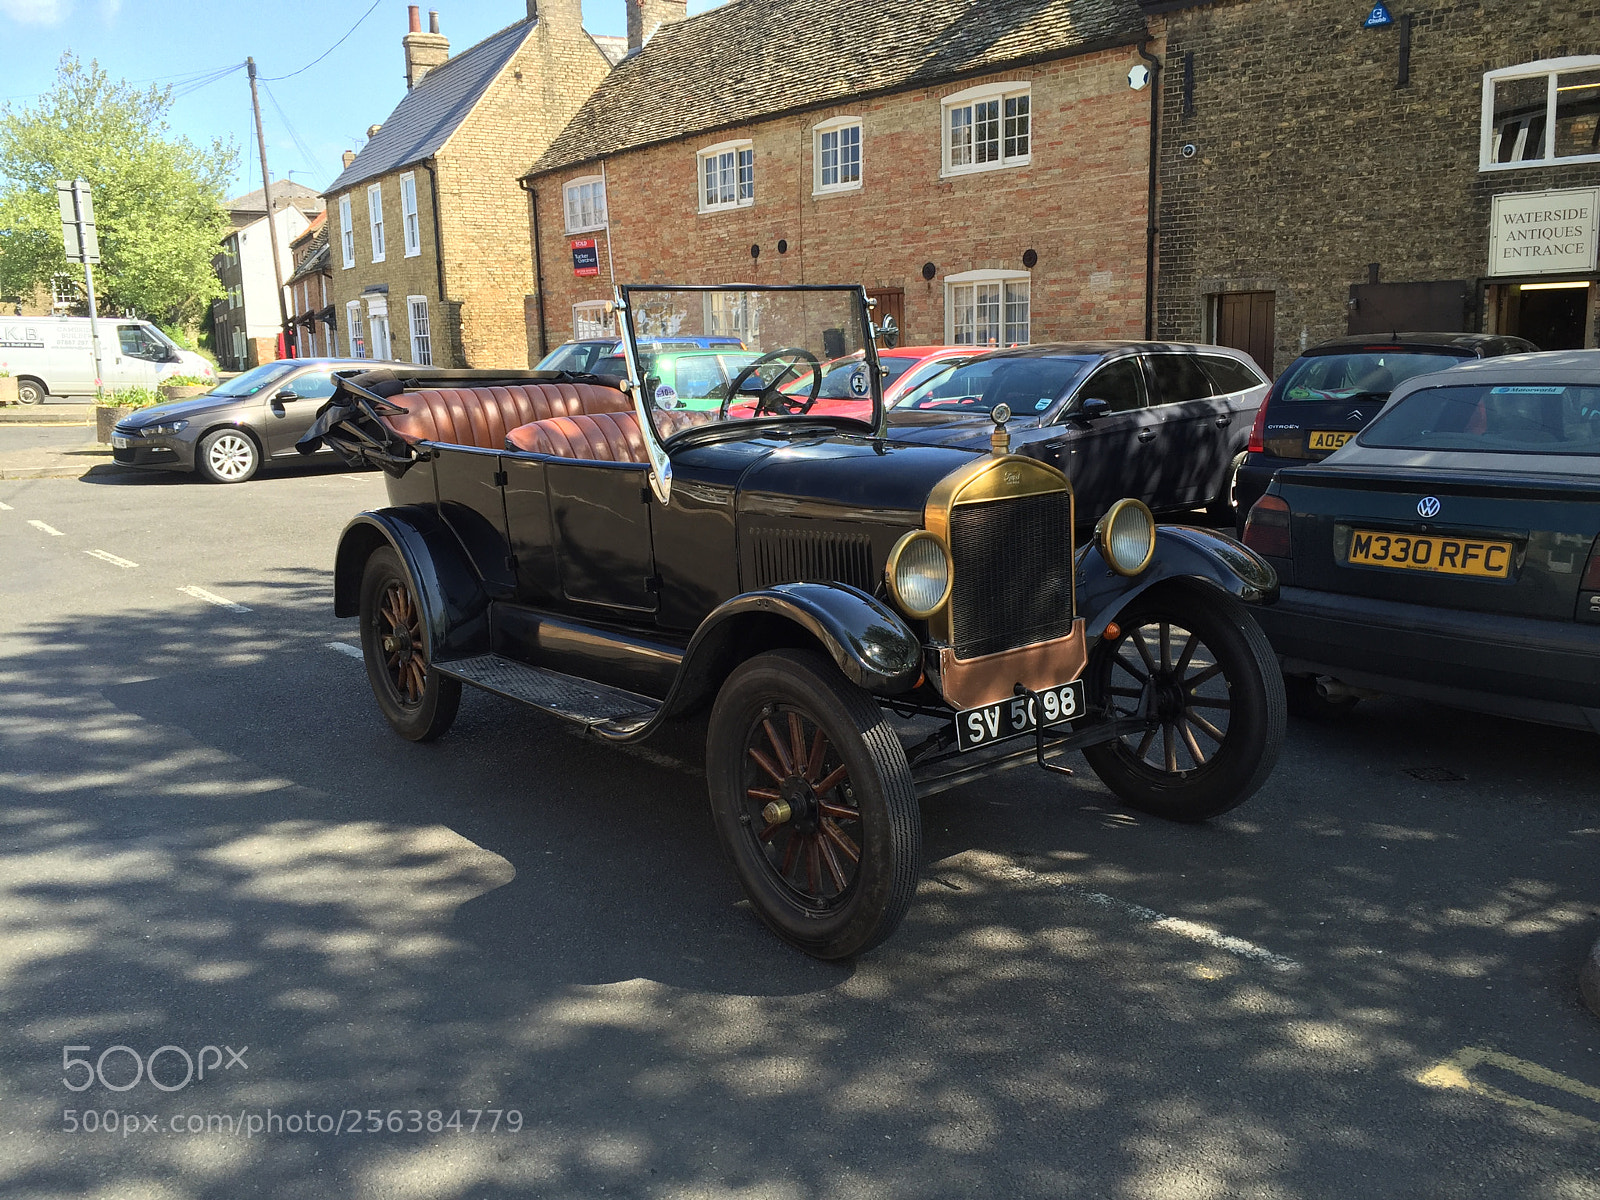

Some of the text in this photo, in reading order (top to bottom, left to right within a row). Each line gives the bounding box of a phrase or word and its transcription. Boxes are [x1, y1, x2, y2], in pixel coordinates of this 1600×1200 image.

[1368, 17, 1387, 25] Chubb
[1503, 207, 1588, 225] WATERSIDE
[1506, 225, 1583, 241] ANTIQUES
[1503, 242, 1585, 259] ENTRANCE
[1352, 535, 1507, 572] M330 RFC
[967, 705, 1000, 743] SV
